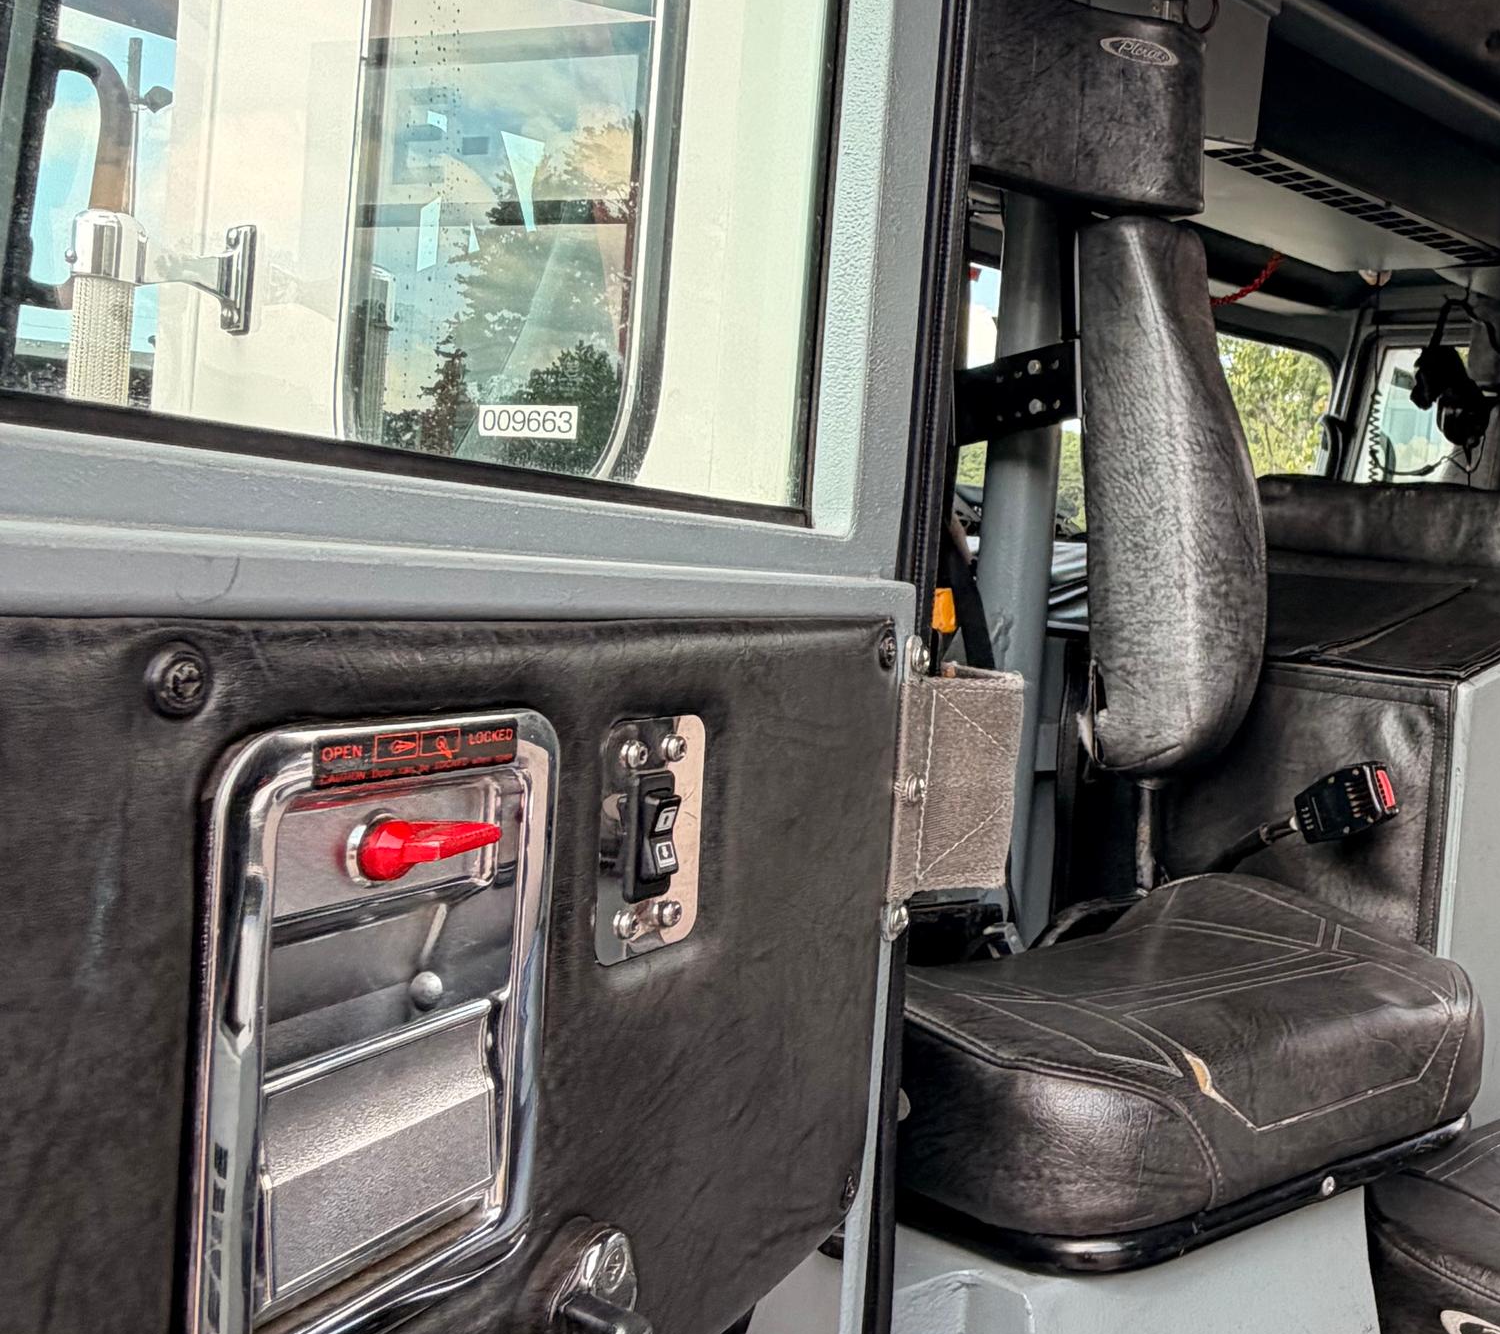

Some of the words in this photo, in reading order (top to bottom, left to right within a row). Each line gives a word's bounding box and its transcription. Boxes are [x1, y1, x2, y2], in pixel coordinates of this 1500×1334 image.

[482, 409, 573, 434] 009663
[321, 745, 364, 763] OPEN
[467, 728, 514, 746] LOCKED
